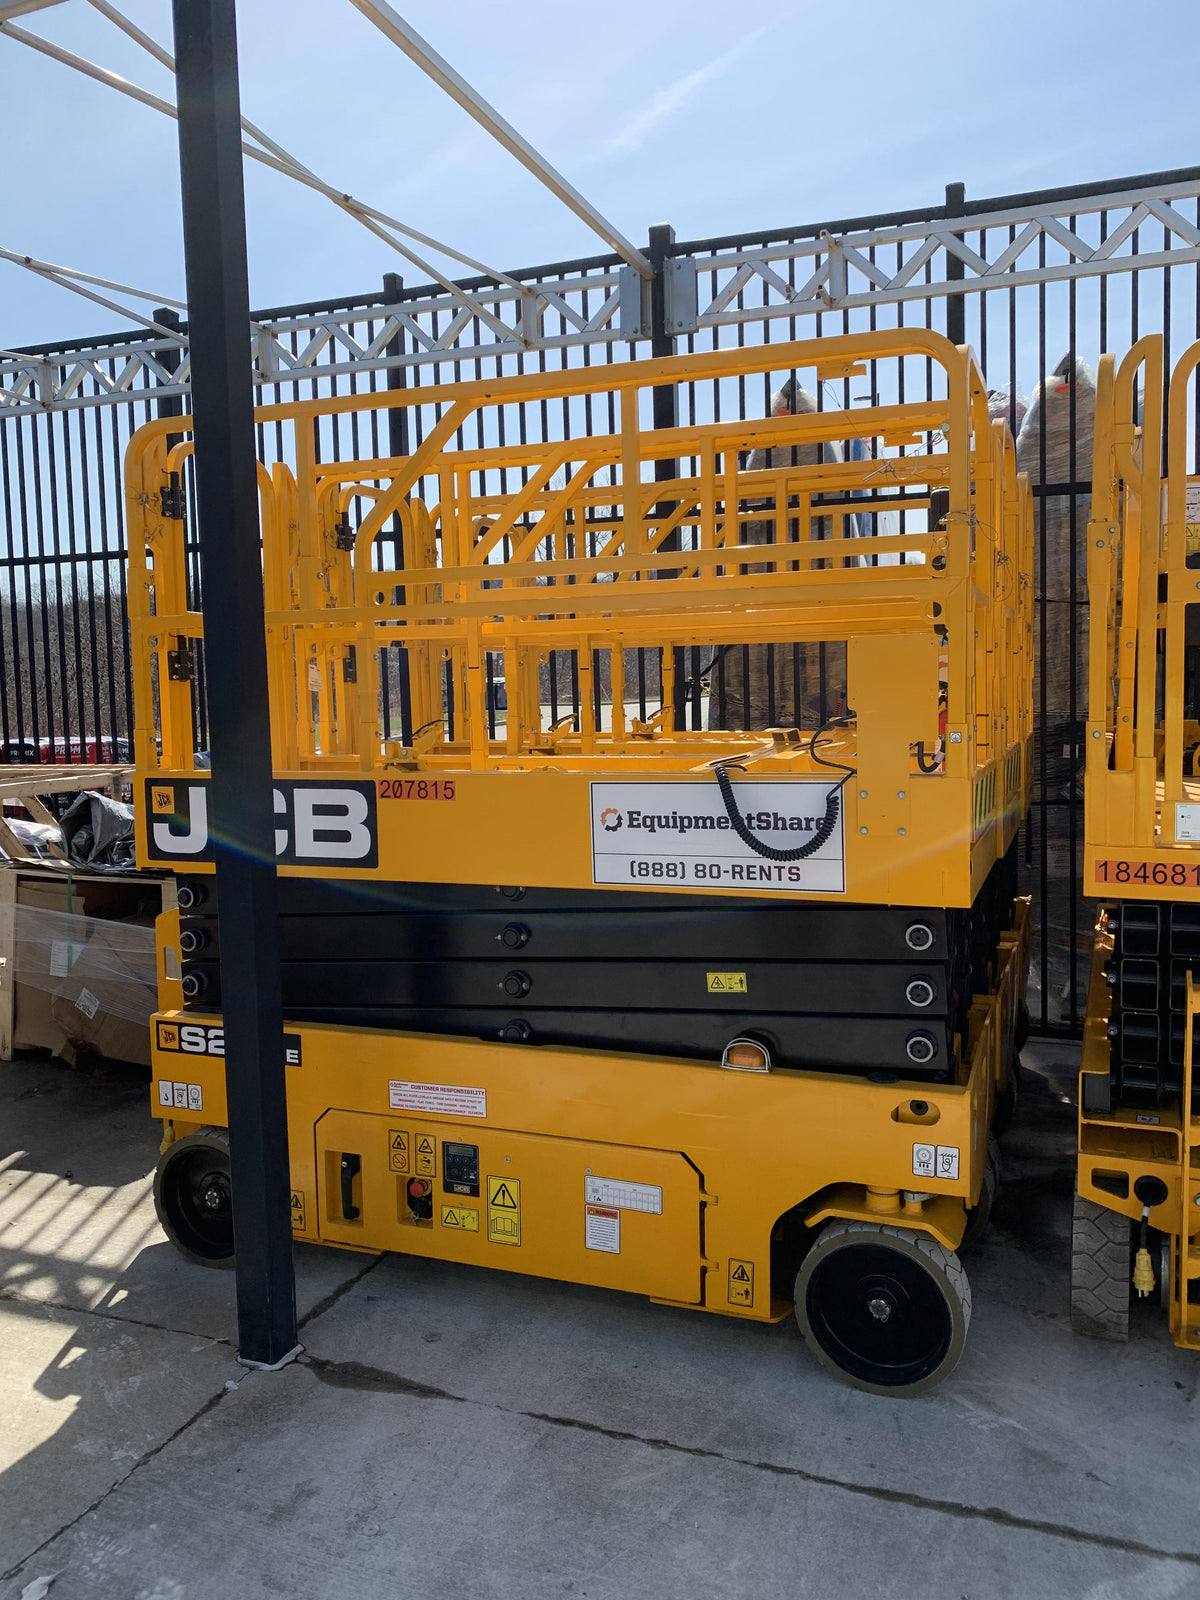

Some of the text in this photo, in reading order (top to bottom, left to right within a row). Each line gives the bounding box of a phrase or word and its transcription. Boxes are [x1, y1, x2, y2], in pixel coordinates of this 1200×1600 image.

[380, 780, 455, 800] 207815
[153, 786, 371, 859] JB
[626, 810, 827, 834] EquipmetShare
[630, 860, 801, 882] (888) 80-RENTS
[1099, 860, 1200, 886] 184681
